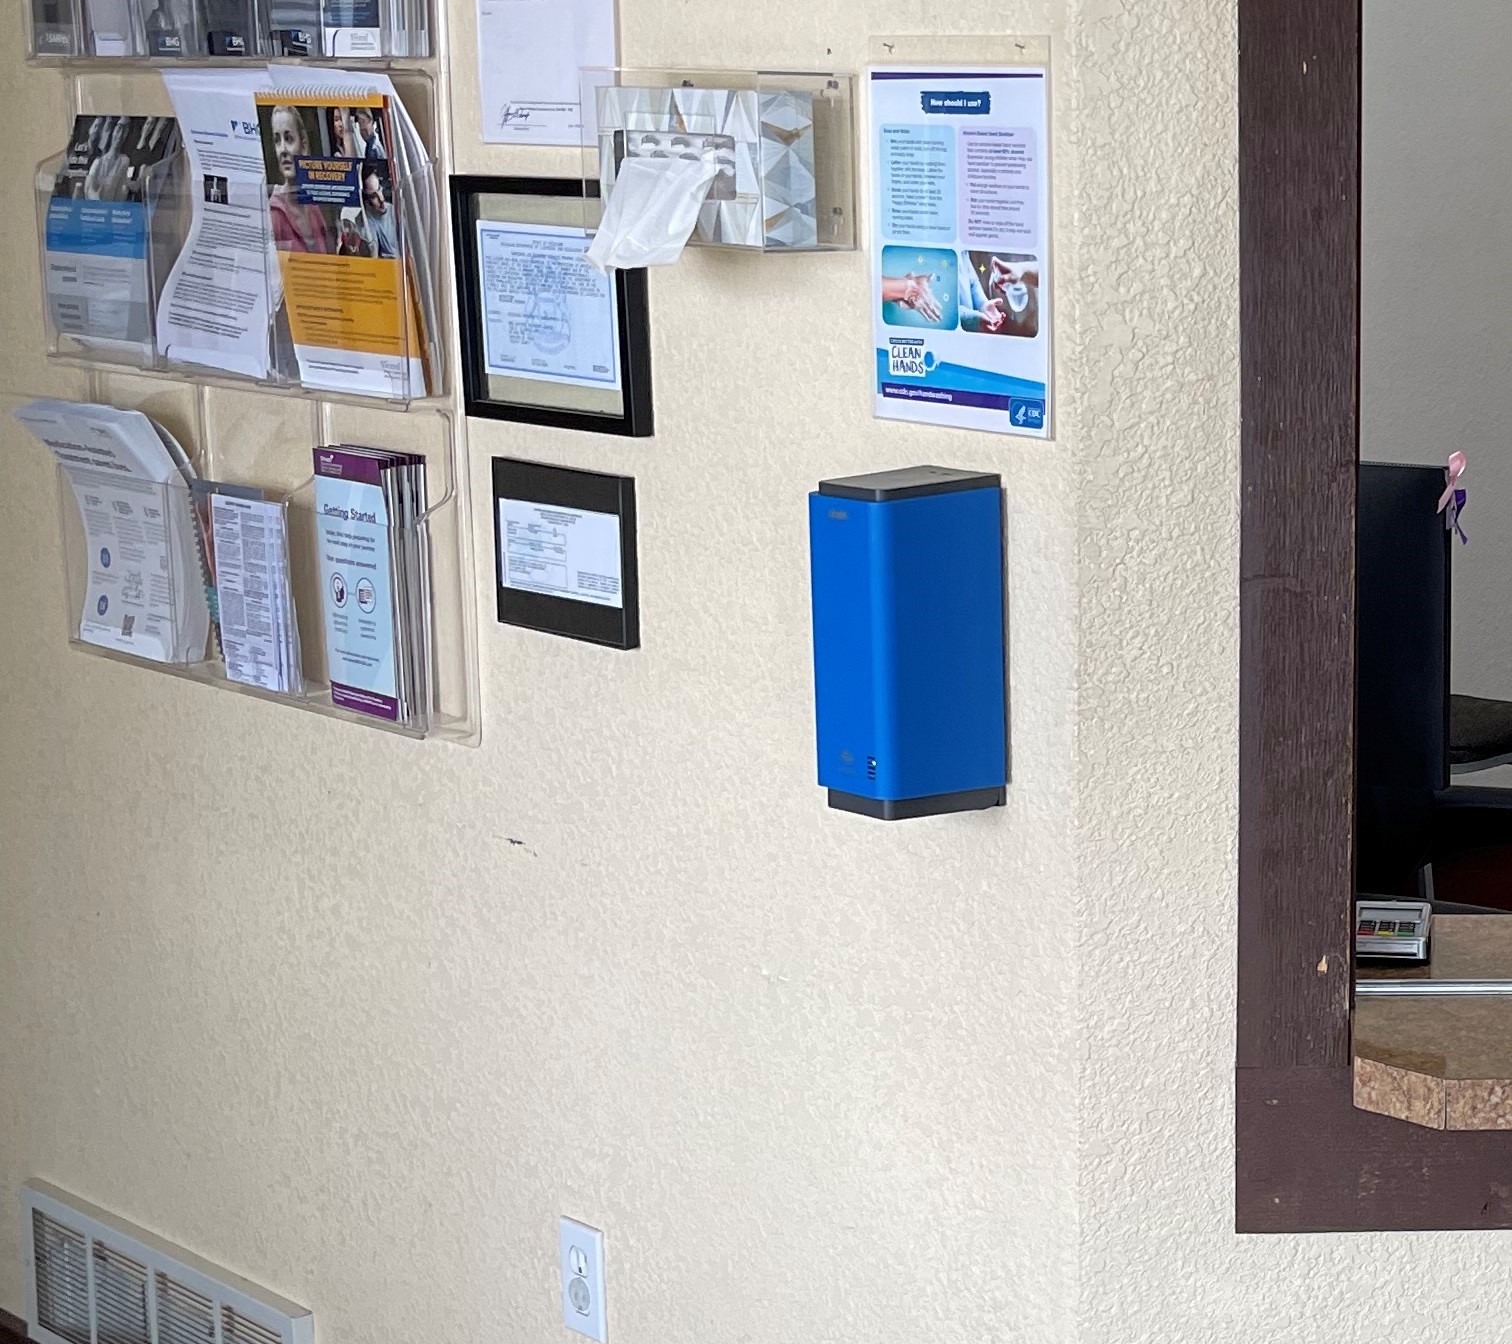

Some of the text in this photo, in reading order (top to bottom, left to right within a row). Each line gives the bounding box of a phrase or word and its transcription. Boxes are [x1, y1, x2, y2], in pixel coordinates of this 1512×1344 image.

[891, 346, 921, 359] CLEAN
[892, 360, 924, 374] HANDS
[323, 503, 376, 524] Getting Started
